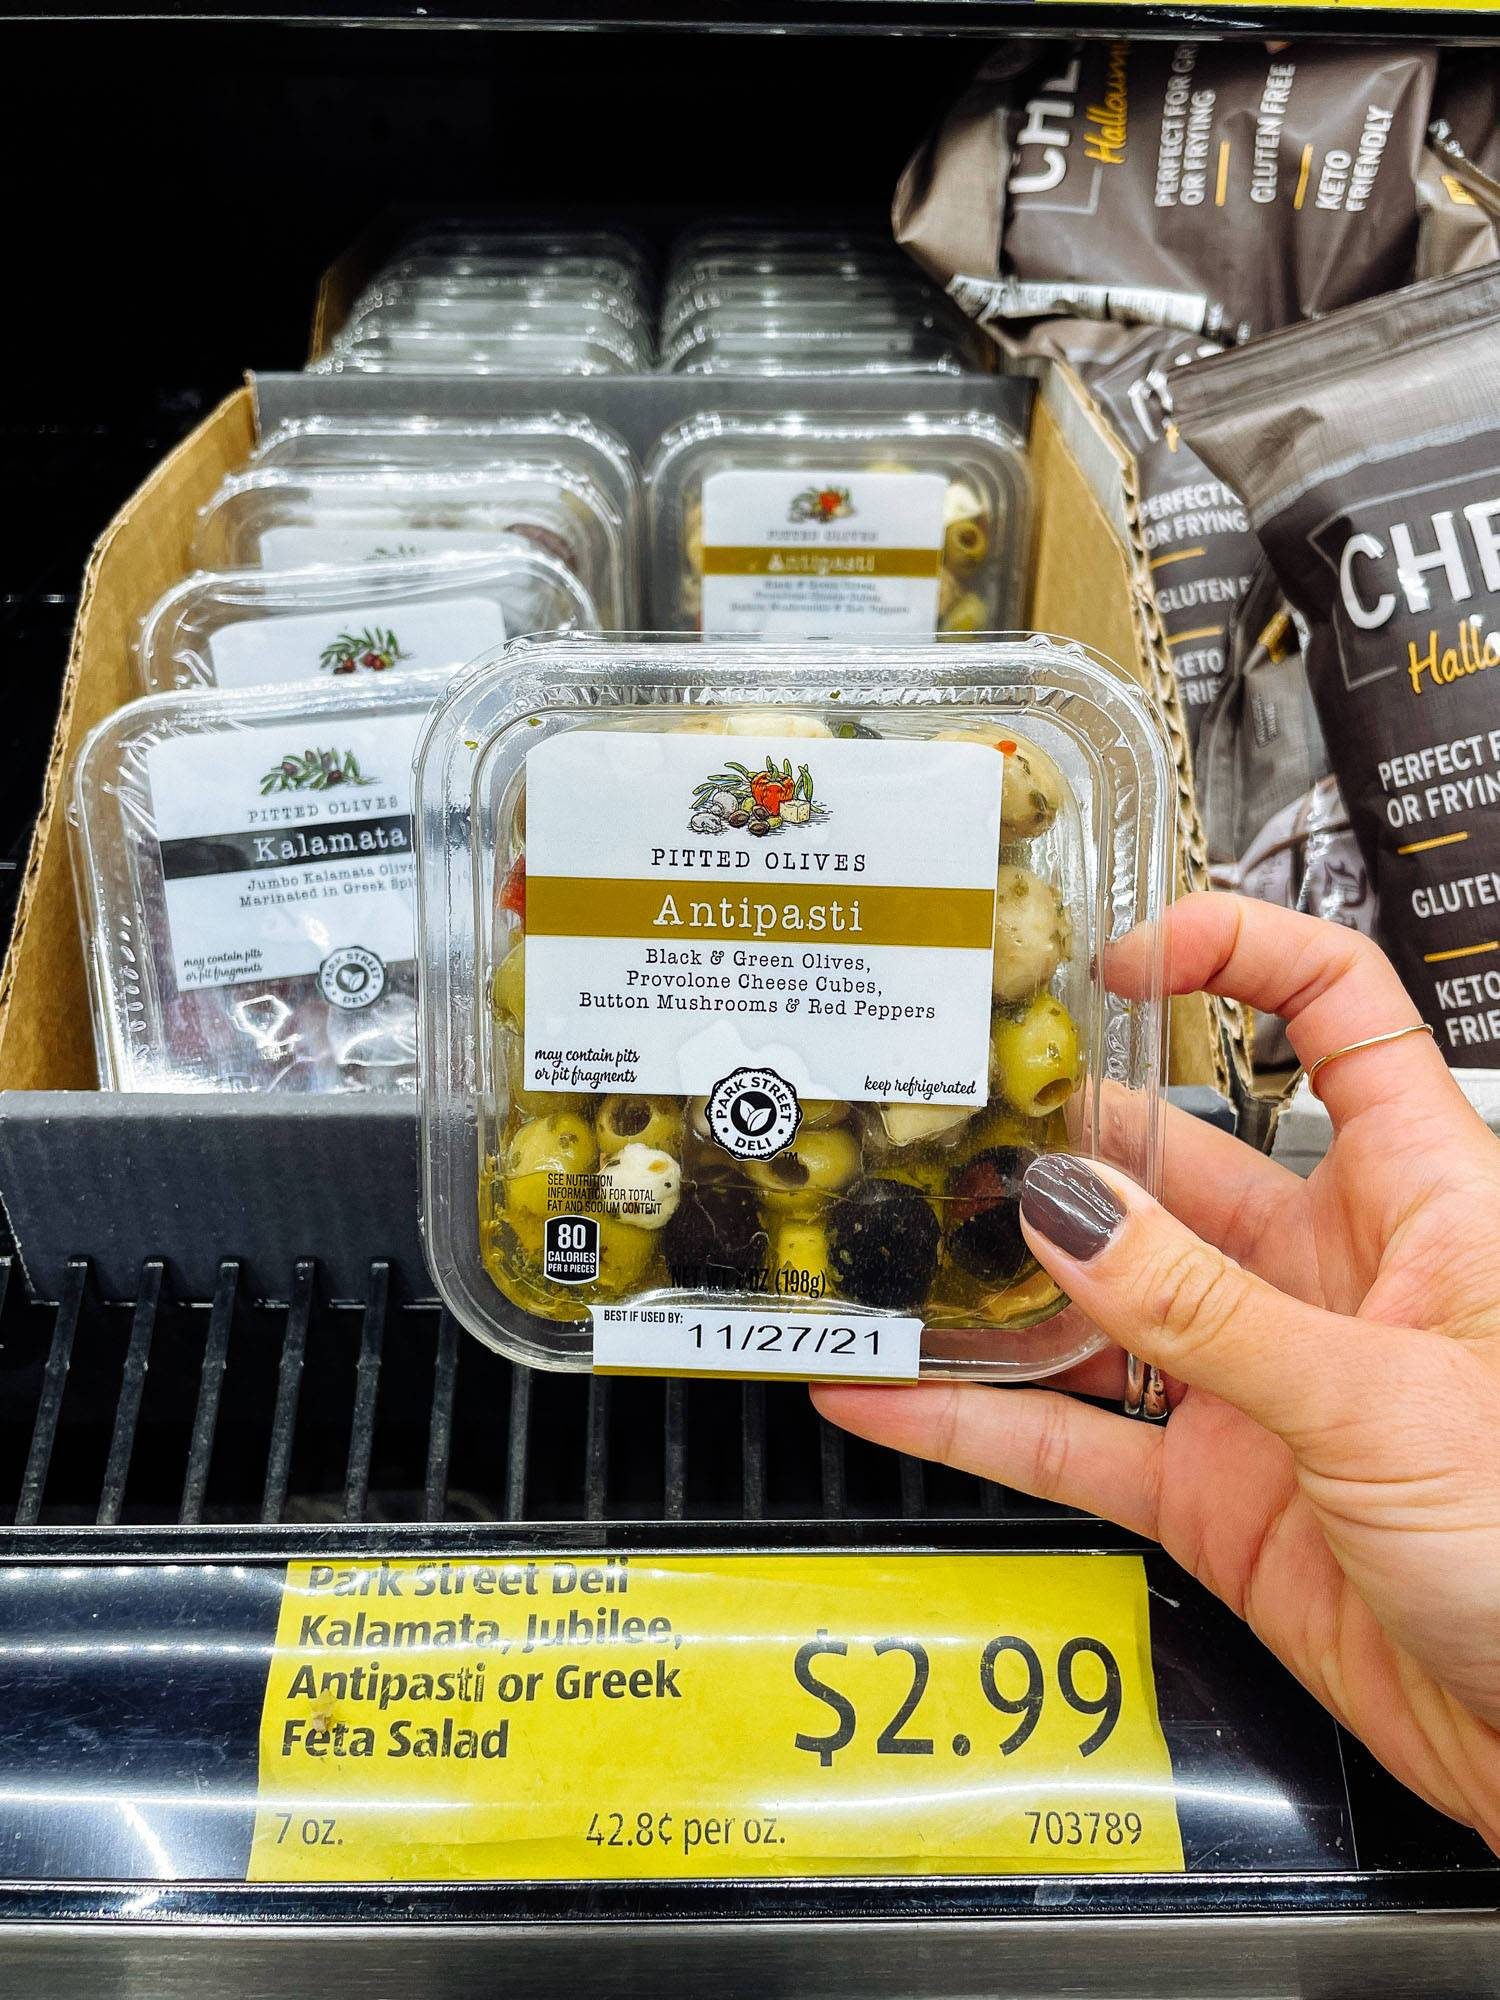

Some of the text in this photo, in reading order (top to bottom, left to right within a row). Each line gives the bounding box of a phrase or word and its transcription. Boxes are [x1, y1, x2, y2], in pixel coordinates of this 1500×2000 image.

[1164, 75, 1192, 116] FOR
[1180, 89, 1216, 206] OR FRYING
[1250, 64, 1296, 203] GLUTEN FREE
[1155, 116, 1185, 207] PERFECT
[1346, 104, 1393, 211] FRIENDLY
[1315, 150, 1351, 210] KETO
[1144, 507, 1249, 549] OR FRYING
[1155, 577, 1237, 613] GLUTEN
[1377, 734, 1483, 791] PERFECT
[248, 796, 399, 824] PITTED OLIVES
[1387, 770, 1500, 829] OR FRYIN
[253, 826, 408, 863] Kalamata
[651, 847, 866, 873] PITTED OLIVES
[240, 889, 318, 908] Marinated
[323, 884, 338, 898] in
[344, 880, 386, 895] Greek
[248, 874, 299, 891] Jumbo
[303, 868, 374, 885] Kalamata
[652, 893, 864, 938] Antipasti
[184, 955, 204, 969] may
[207, 950, 243, 966] contain
[214, 963, 263, 982] fragments
[645, 948, 872, 974] Black & Green Olives,
[343, 992, 370, 1003] DELI
[626, 970, 884, 998] Provolone Cheese Cubes,
[1435, 970, 1500, 1010] KETO
[578, 991, 937, 1021] Button Mushrooms & Red Peppers
[535, 1048, 640, 1068] may contain pits
[535, 1065, 637, 1089] or pit fragments
[864, 1075, 977, 1101] keep refrigerated
[716, 1076, 792, 1123] PARK STREET
[734, 1136, 772, 1151] DELI
[783, 1151, 798, 1161] TM
[547, 1172, 613, 1187] SEE NUTRITION
[547, 1186, 656, 1202] INFORMATION FOR TOTAL
[547, 1199, 662, 1215] FAT AND SODIUM CONTENT
[557, 1223, 586, 1250] 80
[547, 1250, 596, 1264] CALORIES
[547, 1263, 595, 1274] PER 8 PIECES
[775, 1269, 827, 1299] (198g)
[603, 1309, 684, 1325] BEST IF USED BY:
[687, 1323, 880, 1356] 11/27/21
[308, 1557, 629, 1597] Park Street Deli
[298, 1609, 683, 1655] Kalamata, Jubilee,
[286, 1659, 682, 1710] Antipasti or Greek
[794, 1628, 1123, 1767] $2.99
[281, 1717, 510, 1758] Feta Salad
[275, 1812, 344, 1846] 7 oz.
[586, 1812, 787, 1856] 42.8¢ per oz.
[1023, 1810, 1143, 1846] 703789
